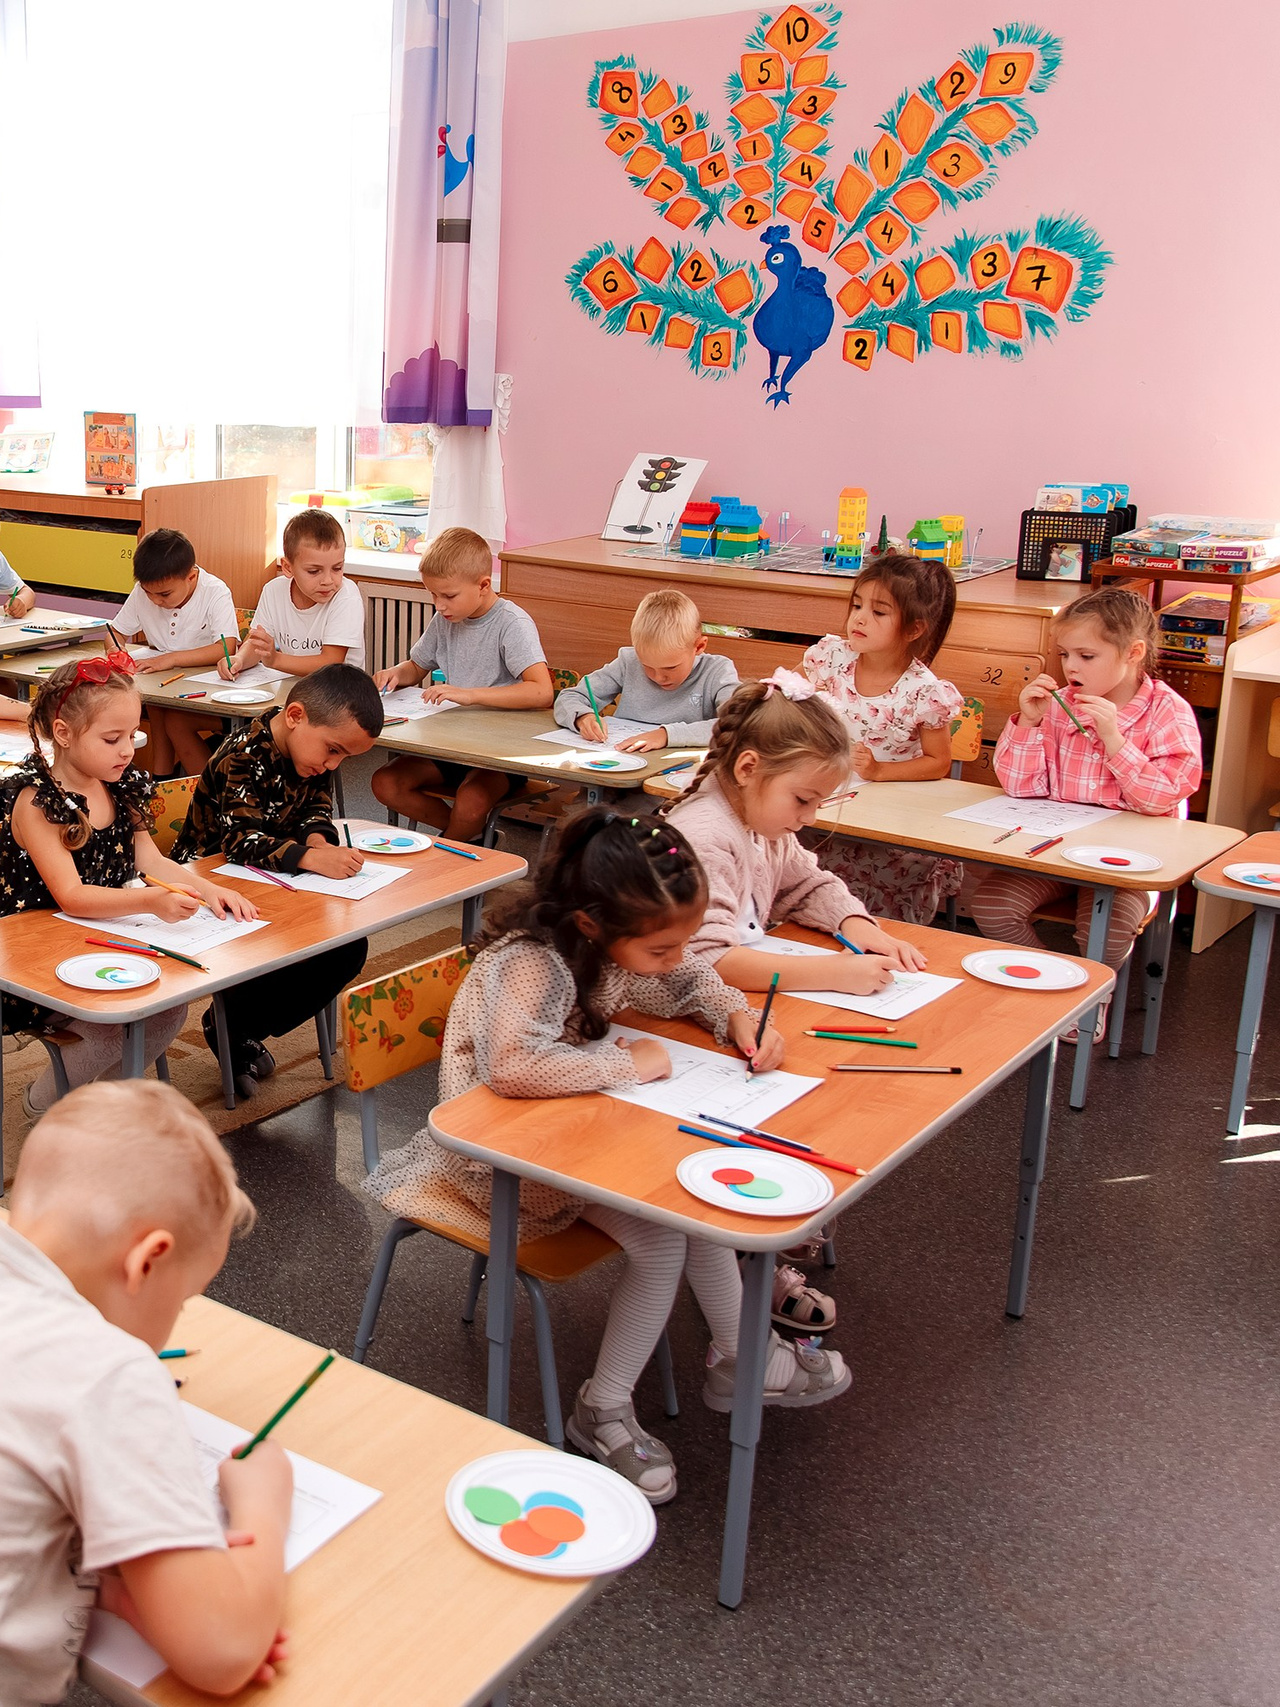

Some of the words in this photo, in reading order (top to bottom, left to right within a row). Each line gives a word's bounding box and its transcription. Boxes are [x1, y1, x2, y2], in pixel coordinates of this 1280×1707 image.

[785, 16, 809, 46] 10
[757, 58, 773, 85] 5
[999, 62, 1016, 84] 9
[611, 81, 633, 103] 8
[949, 71, 966, 98] 2
[801, 95, 818, 115] 3
[672, 114, 687, 135] 3
[618, 130, 635, 143] 4
[752, 139, 757, 156] 1
[707, 161, 724, 178] 2
[884, 148, 889, 170] 1
[942, 153, 961, 177] 3
[800, 161, 813, 182] 4
[660, 181, 673, 192] 1
[744, 204, 758, 225] 2
[810, 219, 826, 238] 5
[881, 220, 893, 243] 4
[689, 259, 707, 282] 2
[981, 251, 998, 277] 3
[602, 270, 619, 293] 6
[882, 269, 895, 295] 4
[1026, 265, 1052, 291] 7
[640, 311, 647, 330] 1
[944, 322, 949, 339] 1
[710, 341, 723, 361] 3
[854, 337, 868, 360] 2
[120, 548, 133, 560] 29
[1182, 546, 1192, 554] 60
[1115, 556, 1125, 564] 60
[1149, 561, 1173, 569] PUZZLE
[979, 666, 1003, 686] 32
